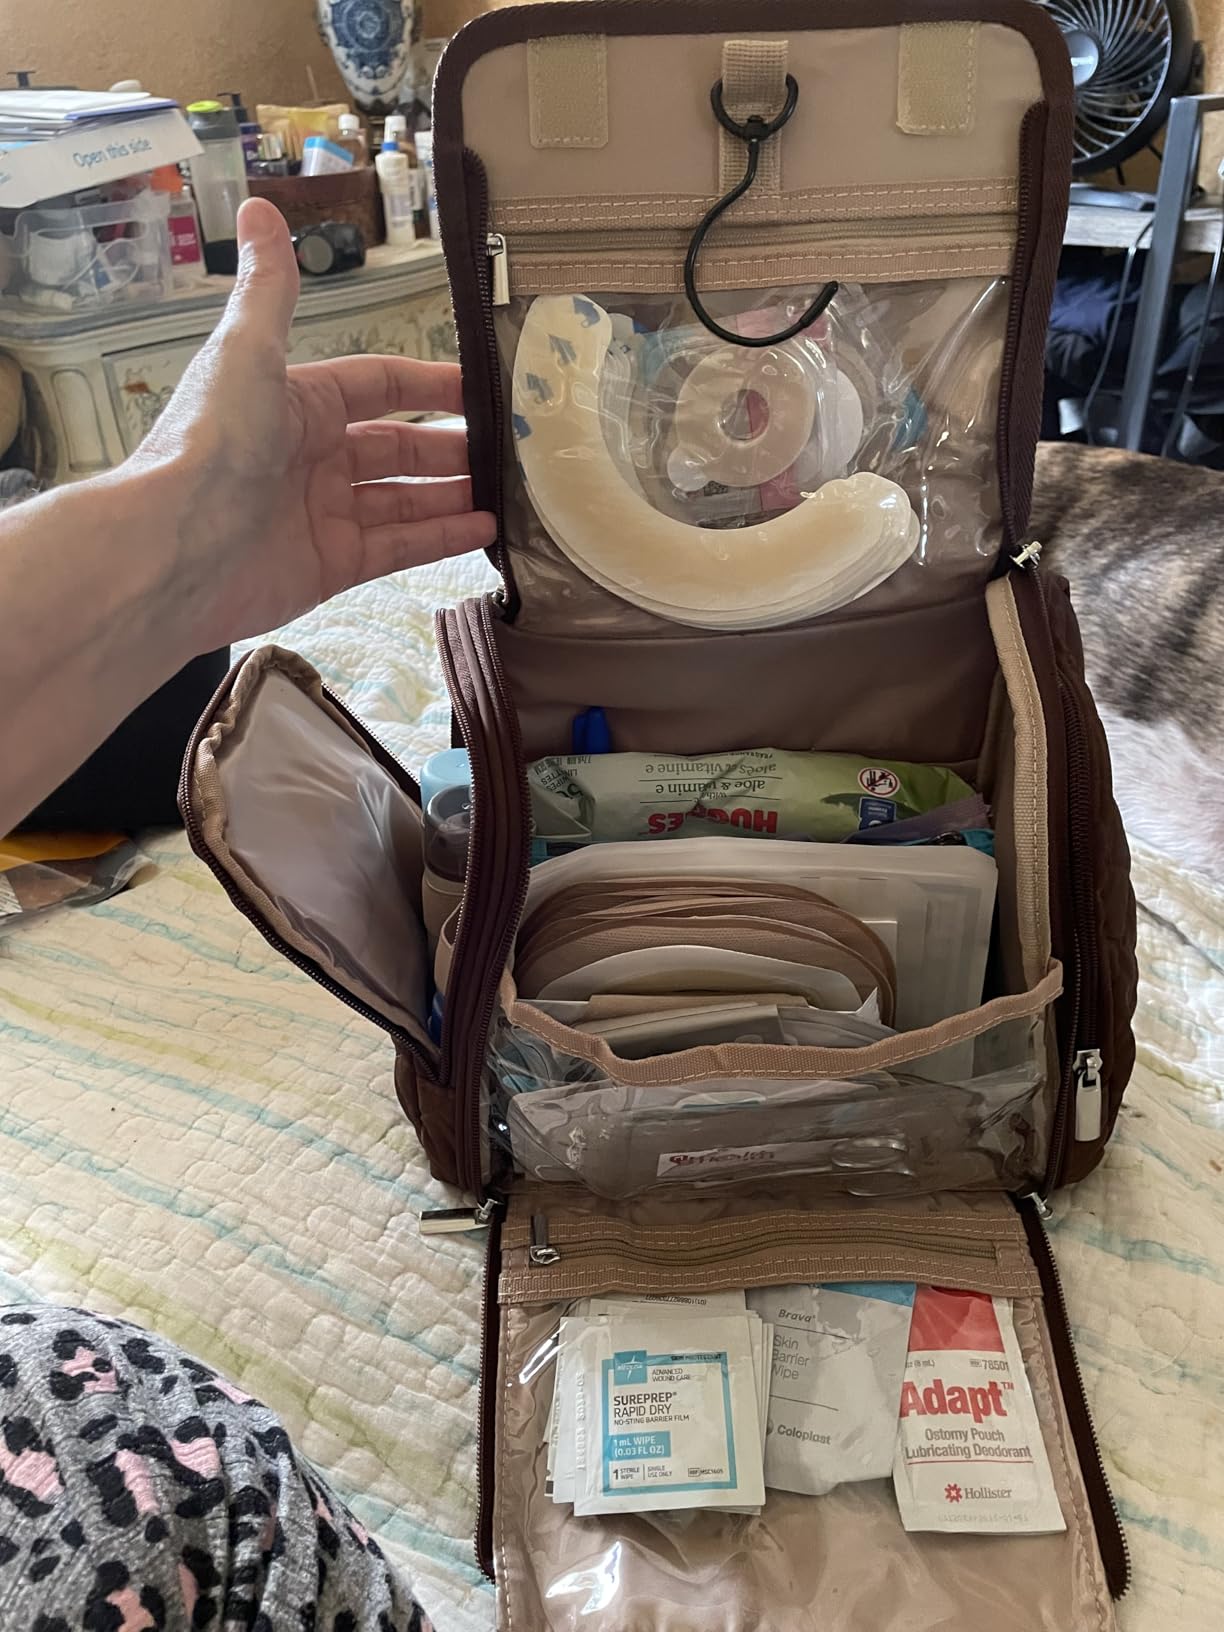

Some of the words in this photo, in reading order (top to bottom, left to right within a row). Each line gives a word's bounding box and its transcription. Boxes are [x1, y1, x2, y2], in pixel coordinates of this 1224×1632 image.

[73, 150, 107, 168] Open
[107, 144, 130, 159] this
[129, 138, 153, 155] side
[645, 764, 654, 774] e
[657, 762, 723, 776] vitamine
[738, 763, 777, 776] aloès
[655, 784, 664, 794] e
[668, 783, 717, 796] vamin
[720, 782, 732, 791] &
[734, 780, 766, 792] aloe
[647, 808, 778, 834] HUGES
[774, 1334, 799, 1350] Skin
[772, 1348, 810, 1367] Barrier
[982, 1359, 1009, 1372] 78501
[614, 1406, 646, 1418] RAPID
[649, 1404, 672, 1416] DRY
[614, 1418, 644, 1426] NO-STING
[777, 1424, 831, 1445] Coloplast
[925, 1428, 968, 1442] Ostomy
[970, 1427, 1005, 1441] Pouch
[619, 1438, 632, 1447] mL
[633, 1436, 656, 1445] WIPE
[614, 1448, 636, 1458] (0.03
[638, 1446, 648, 1455] FL
[649, 1445, 665, 1455] OZ)
[905, 1444, 971, 1459] Lubricating
[973, 1443, 1032, 1458] Deodorant
[613, 1468, 619, 1480] 1
[964, 1487, 1012, 1499] Hollister
